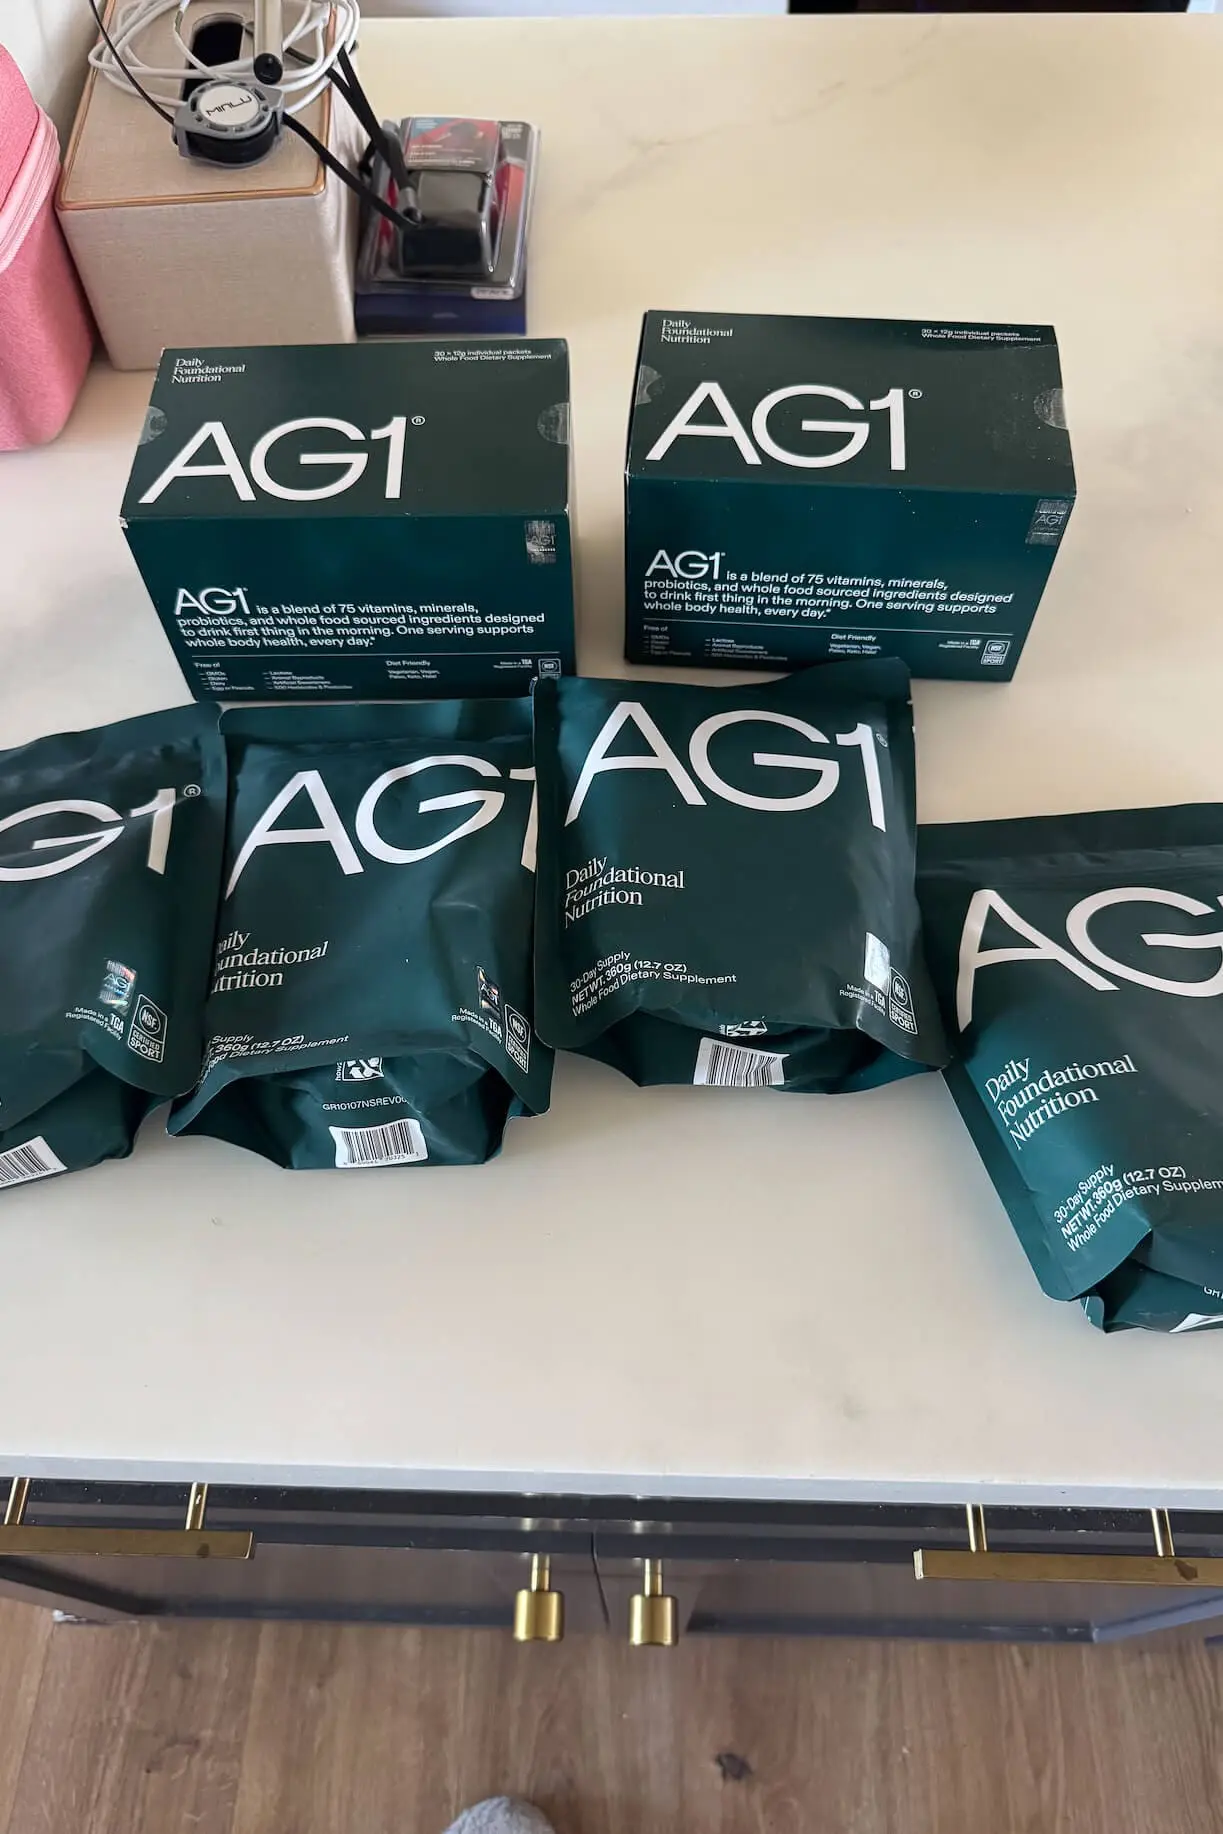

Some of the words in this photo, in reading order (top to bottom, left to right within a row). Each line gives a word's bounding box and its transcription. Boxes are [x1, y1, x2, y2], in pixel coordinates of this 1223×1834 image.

[206, 95, 253, 116] MINLU
[662, 319, 691, 329] Daily
[662, 327, 733, 337] Foundational
[661, 334, 711, 344] Nutrition
[176, 357, 205, 367] Daily
[503, 349, 532, 357] packets
[507, 353, 552, 361] Supplement
[171, 374, 222, 384] Nutrition
[174, 364, 246, 375] Foundational
[726, 571, 738, 581] is
[739, 573, 748, 581] a
[751, 571, 789, 583] blend
[791, 573, 804, 584] of
[807, 574, 824, 584] 75
[826, 575, 885, 588] vitamins,
[887, 577, 948, 591] minerals,
[644, 580, 711, 592] probiotics,
[714, 582, 738, 592] and
[741, 583, 781, 594] whole
[783, 584, 814, 596] food
[815, 586, 870, 598] sourced
[872, 588, 947, 601] ingredients
[950, 591, 1014, 605] designed
[644, 590, 657, 600] to
[660, 590, 692, 601] drink
[693, 591, 720, 602] first
[722, 592, 754, 606] thing
[757, 594, 769, 605] in
[772, 595, 793, 606] the
[795, 597, 853, 610] morning.
[855, 598, 883, 609] One
[886, 600, 935, 613] serving
[937, 602, 997, 615] supports
[255, 604, 269, 615] is
[271, 606, 280, 614] a
[282, 604, 320, 615] blend
[322, 604, 337, 614] of
[338, 604, 355, 614] 75
[357, 603, 417, 616] vitamins,
[419, 602, 479, 615] minerals,
[644, 601, 682, 612] whole
[685, 602, 717, 614] body
[719, 603, 762, 616] health,
[764, 607, 800, 619] every
[176, 616, 248, 628] probiotics,
[250, 616, 274, 626] and
[276, 615, 317, 626] whole
[319, 615, 350, 625] food
[352, 614, 406, 625] sourced
[408, 613, 482, 626] ingredients
[484, 613, 545, 626] designed
[180, 628, 196, 637] to
[197, 627, 231, 637] drink
[233, 627, 259, 637] first
[261, 626, 295, 638] thing
[298, 626, 310, 636] in
[312, 626, 334, 636] the
[336, 625, 395, 638] morning.
[396, 624, 424, 635] One
[426, 624, 475, 637] serving
[476, 623, 535, 637] supports
[185, 638, 226, 648] whole
[228, 637, 261, 649] body
[264, 637, 308, 648] health,
[310, 638, 345, 649] every
[566, 856, 607, 890] Daily
[565, 866, 686, 909] Foundational
[565, 887, 643, 929] Nutrition
[956, 886, 1223, 1033] AG
[570, 967, 597, 993] 30-Day
[596, 950, 631, 972] Supply
[606, 962, 632, 981] 360g
[634, 960, 662, 971] (12.7
[663, 963, 687, 973] OZ)
[572, 994, 598, 1017] Whole
[598, 979, 620, 1001] Food
[620, 970, 660, 986] Dietary
[662, 971, 737, 985] Supplement
[65, 1012, 104, 1026] Registered
[74, 1007, 97, 1016] Made
[110, 1013, 124, 1034] TGA
[130, 1037, 161, 1059] SPORT
[211, 1034, 254, 1045] Supply
[214, 1042, 249, 1053] 360g
[250, 1040, 278, 1050] (12.7
[282, 1034, 305, 1045] OZ)
[228, 1047, 274, 1058] Dietary
[275, 1035, 350, 1052] Supplement
[984, 1057, 1030, 1103] Daily
[997, 1054, 1139, 1127] Foundational
[1009, 1087, 1100, 1151] Nutrition
[1053, 1190, 1084, 1223] 30-Day
[1078, 1163, 1114, 1195] Supply
[1092, 1178, 1123, 1204] 360g
[1123, 1168, 1156, 1187] (12.7
[1158, 1165, 1187, 1179] OZ)
[1067, 1222, 1097, 1252] Whole
[1094, 1203, 1116, 1229] Food
[1112, 1183, 1160, 1207] Dietary
